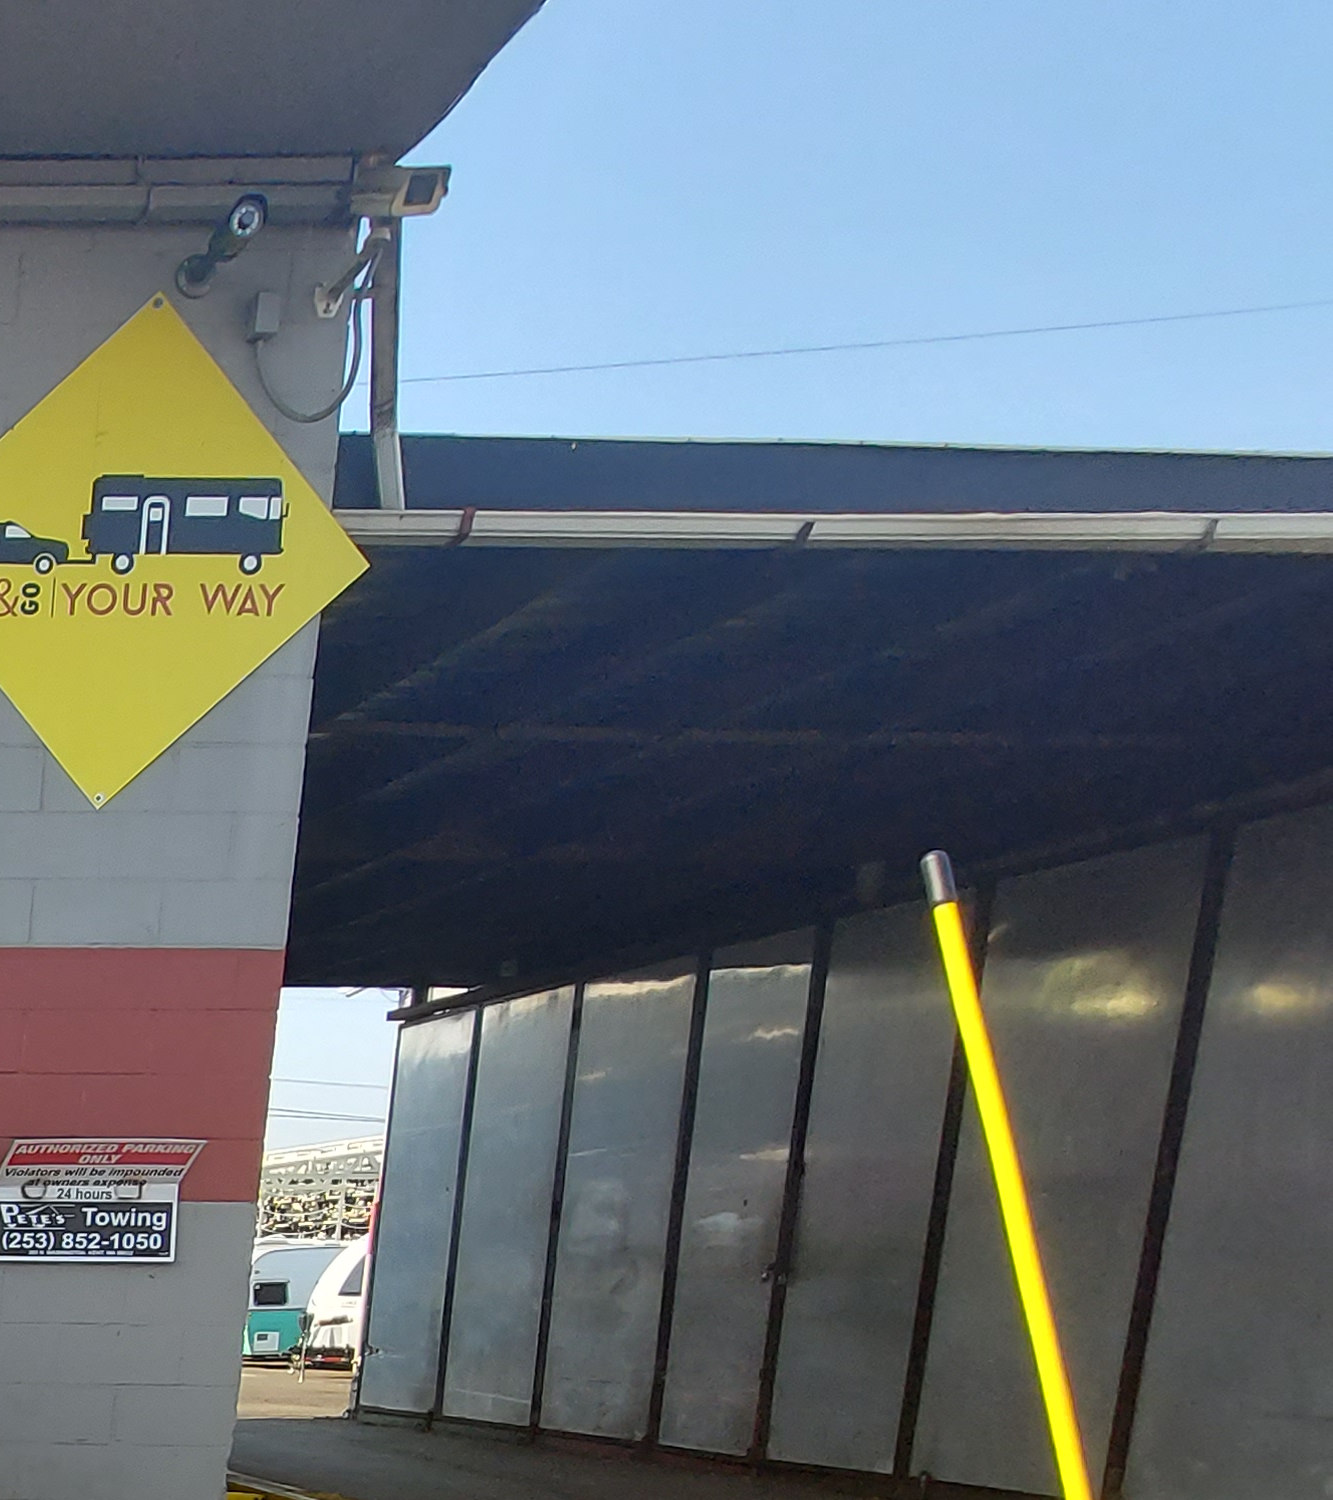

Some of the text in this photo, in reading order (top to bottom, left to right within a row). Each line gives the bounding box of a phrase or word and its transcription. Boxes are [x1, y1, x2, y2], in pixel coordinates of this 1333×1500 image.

[20, 582, 41, 615] GO
[60, 582, 174, 617] YOUR
[199, 582, 286, 617] WAY
[15, 1143, 197, 1155] AUTHORIZED PARKING
[78, 1154, 123, 1164] ONLY
[4, 1167, 185, 1179] Violators will be impounded
[56, 1187, 113, 1200] 24 hours
[81, 1207, 167, 1231] Towing
[1, 1231, 162, 1250] (253) 852-1050
